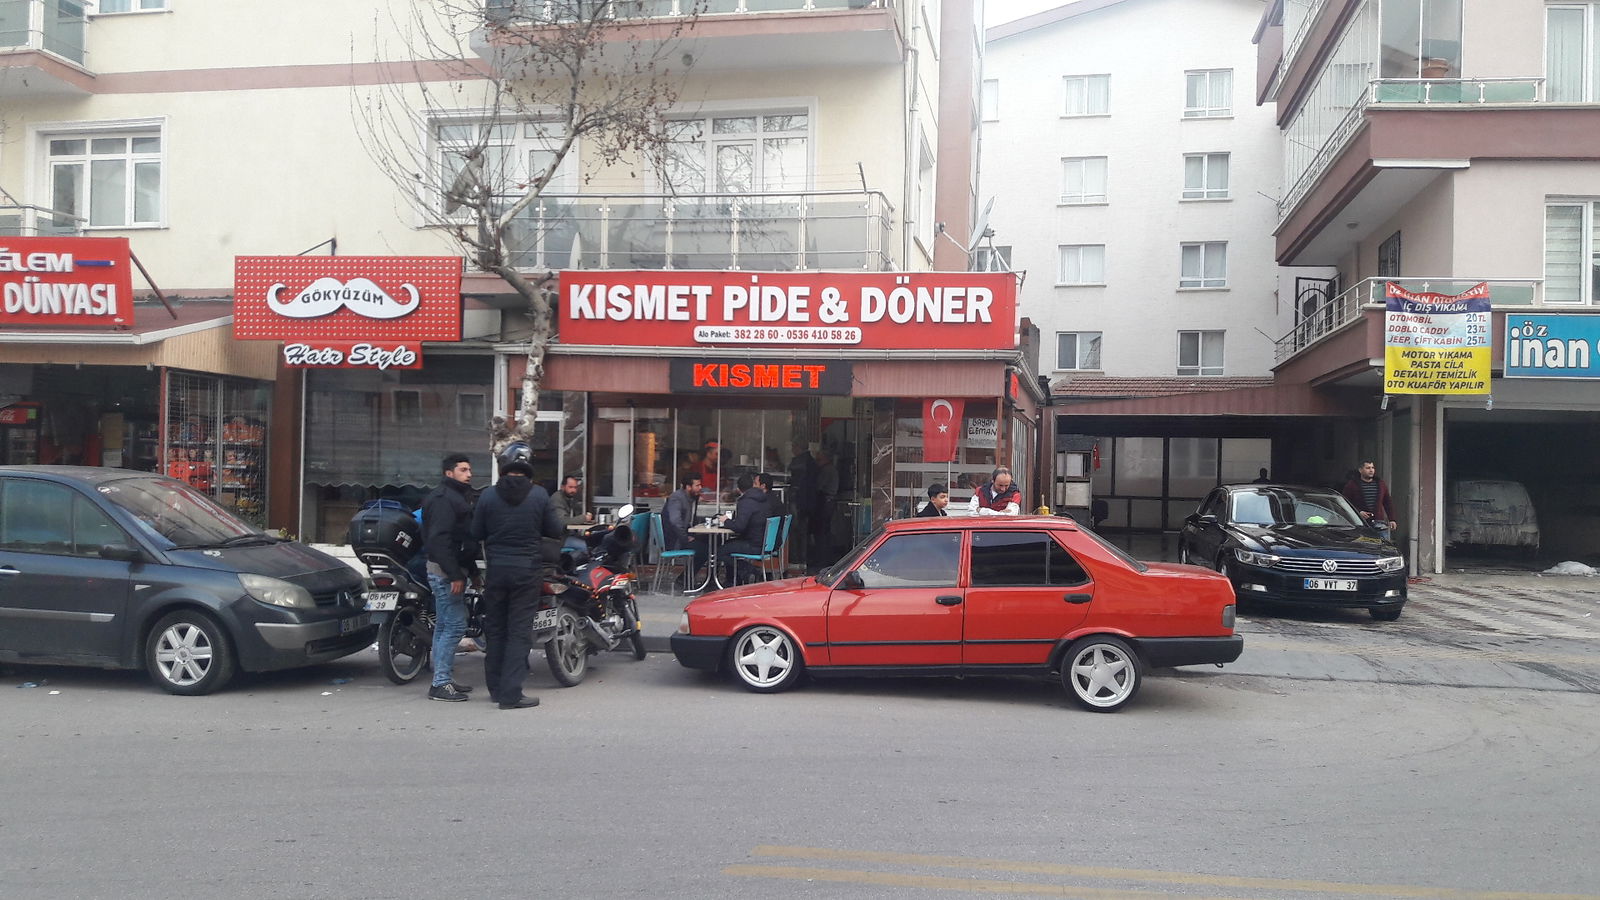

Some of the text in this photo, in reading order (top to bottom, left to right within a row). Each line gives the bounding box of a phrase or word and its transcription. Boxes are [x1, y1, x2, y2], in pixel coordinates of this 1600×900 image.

[4, 275, 118, 315] DÜNYASI
[301, 287, 384, 306] GÖKYÜZÜM
[569, 274, 993, 324] KISMET PİDE & DÖNER
[1403, 301, 1468, 314] İÇ DIŞ YIKAMA
[1389, 314, 1433, 324] OTOMOBİL
[698, 330, 709, 338] Alo
[710, 330, 731, 339] Paket:
[734, 329, 751, 339] 382
[754, 329, 765, 339] 28
[767, 329, 779, 340] 60
[786, 329, 809, 340] 0536
[811, 330, 828, 340] 410
[831, 330, 842, 340] 58
[844, 330, 856, 341] 26
[1388, 325, 1418, 333] DOBLO
[1420, 326, 1449, 335] CADDY
[1414, 335, 1433, 346] ÇİFT
[1434, 336, 1463, 345] KABİN
[1509, 327, 1590, 369] inan
[284, 342, 416, 370] Hair Style
[1401, 350, 1473, 359] MOTOR YIKAMA
[1410, 359, 1464, 369] PASTA CİLA
[693, 363, 826, 389] KISMET
[1393, 369, 1477, 379] DETAYLI TEMİZLİK
[1387, 379, 1485, 390] OTO KUAFÖR YAPILIR
[1309, 579, 1319, 589] 06
[1346, 581, 1356, 590] 37
[369, 593, 379, 601] 06
[545, 609, 557, 618] GE
